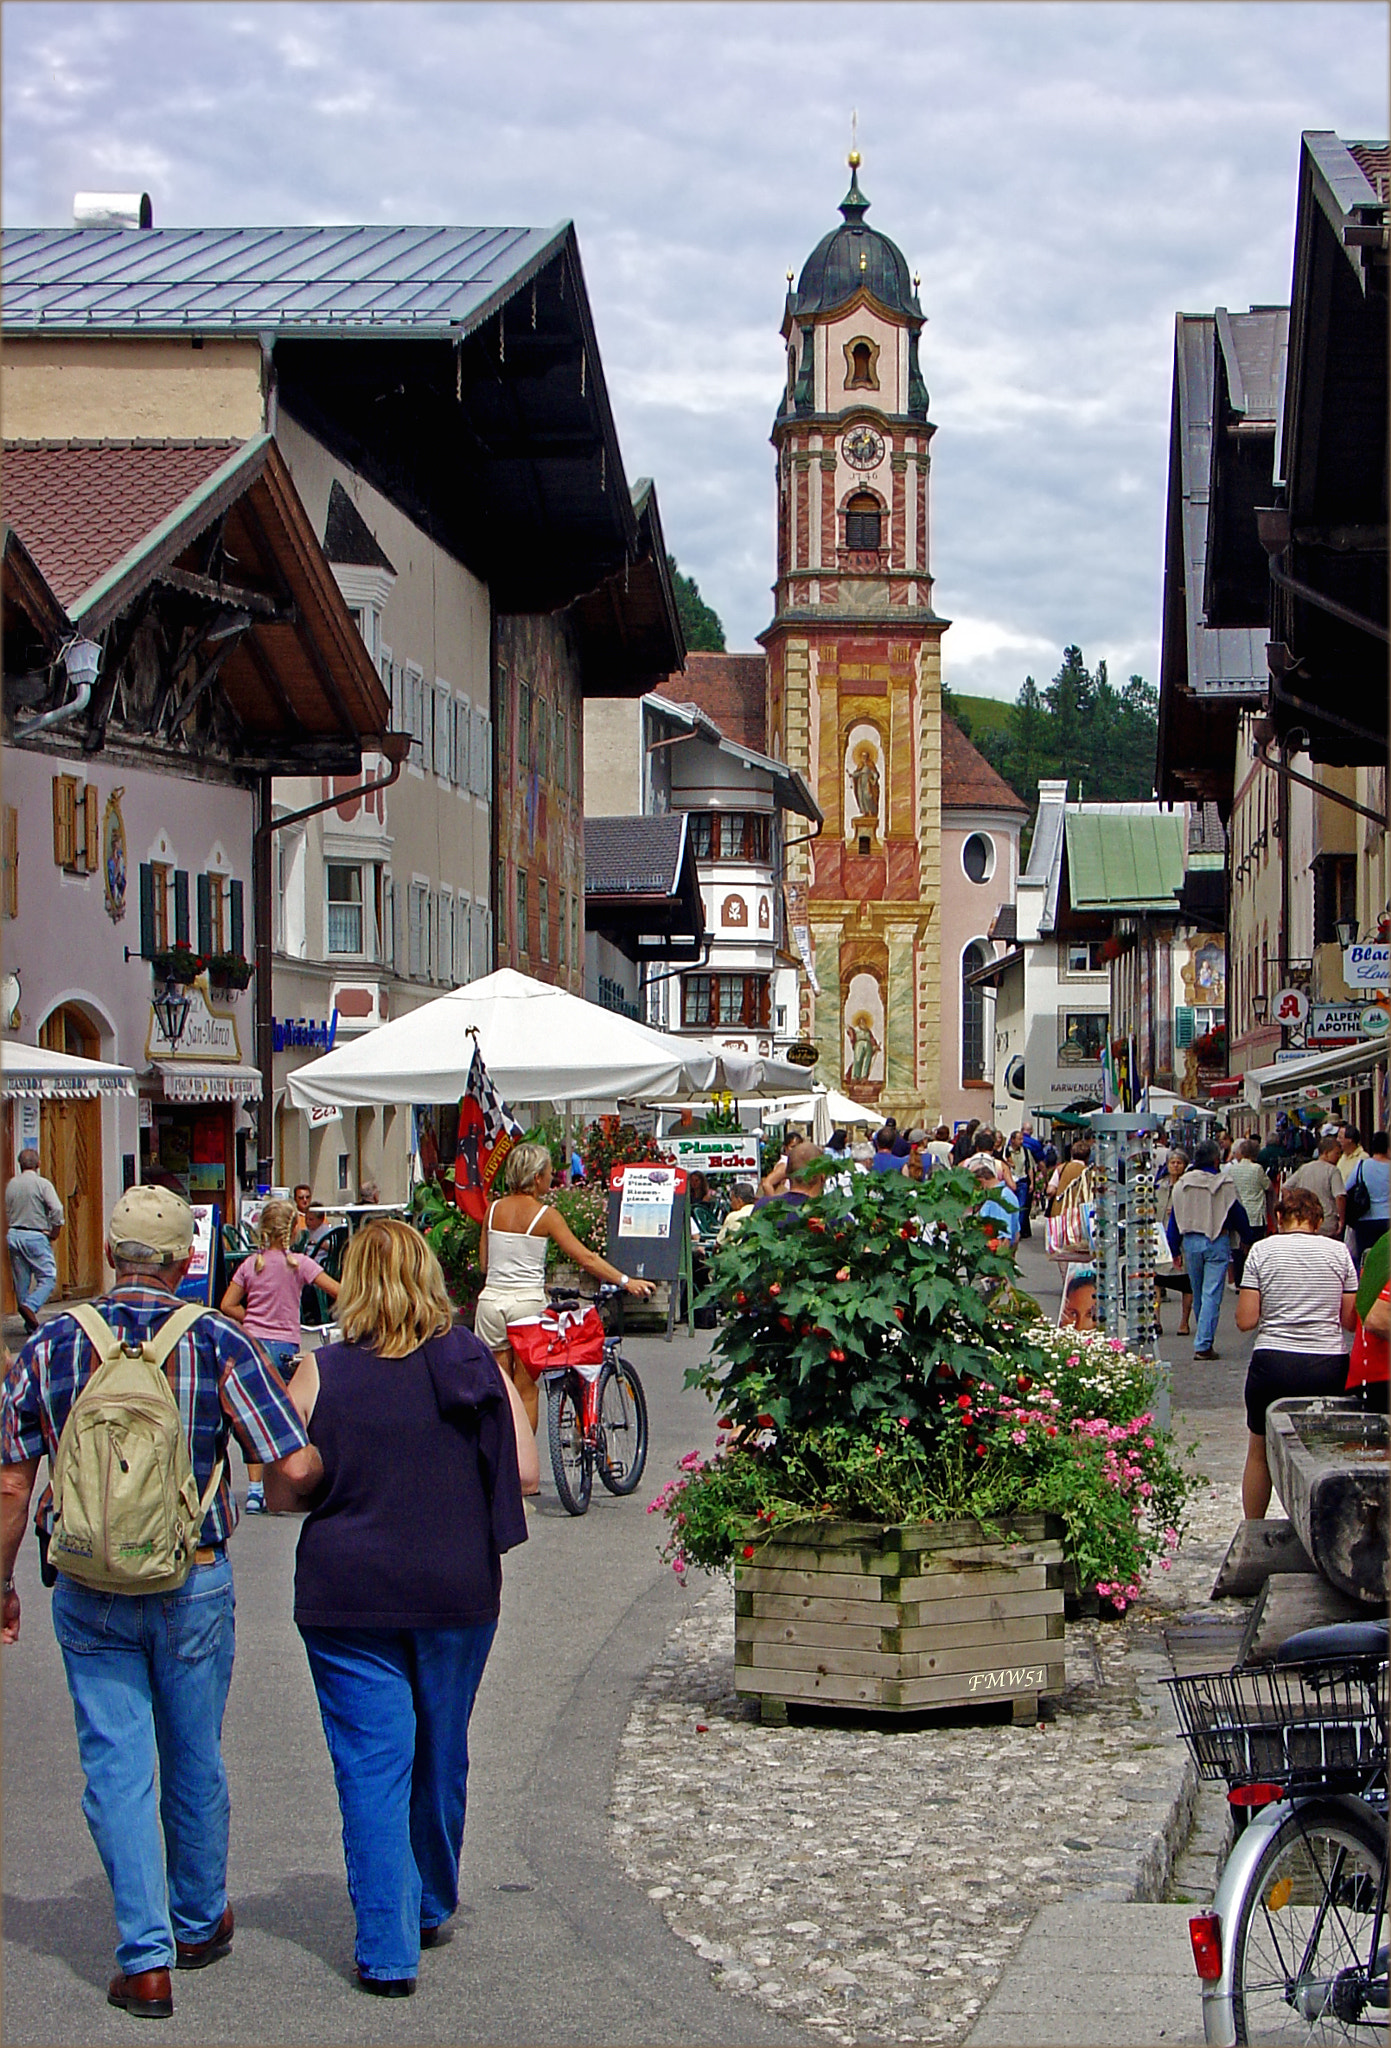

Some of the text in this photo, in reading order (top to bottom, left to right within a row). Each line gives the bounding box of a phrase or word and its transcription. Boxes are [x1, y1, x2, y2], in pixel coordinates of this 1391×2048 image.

[1351, 947, 1389, 963] Blac
[1325, 1012, 1362, 1022] ALPEN
[679, 1141, 744, 1154] Pizza-
[708, 1154, 756, 1168] Ecke
